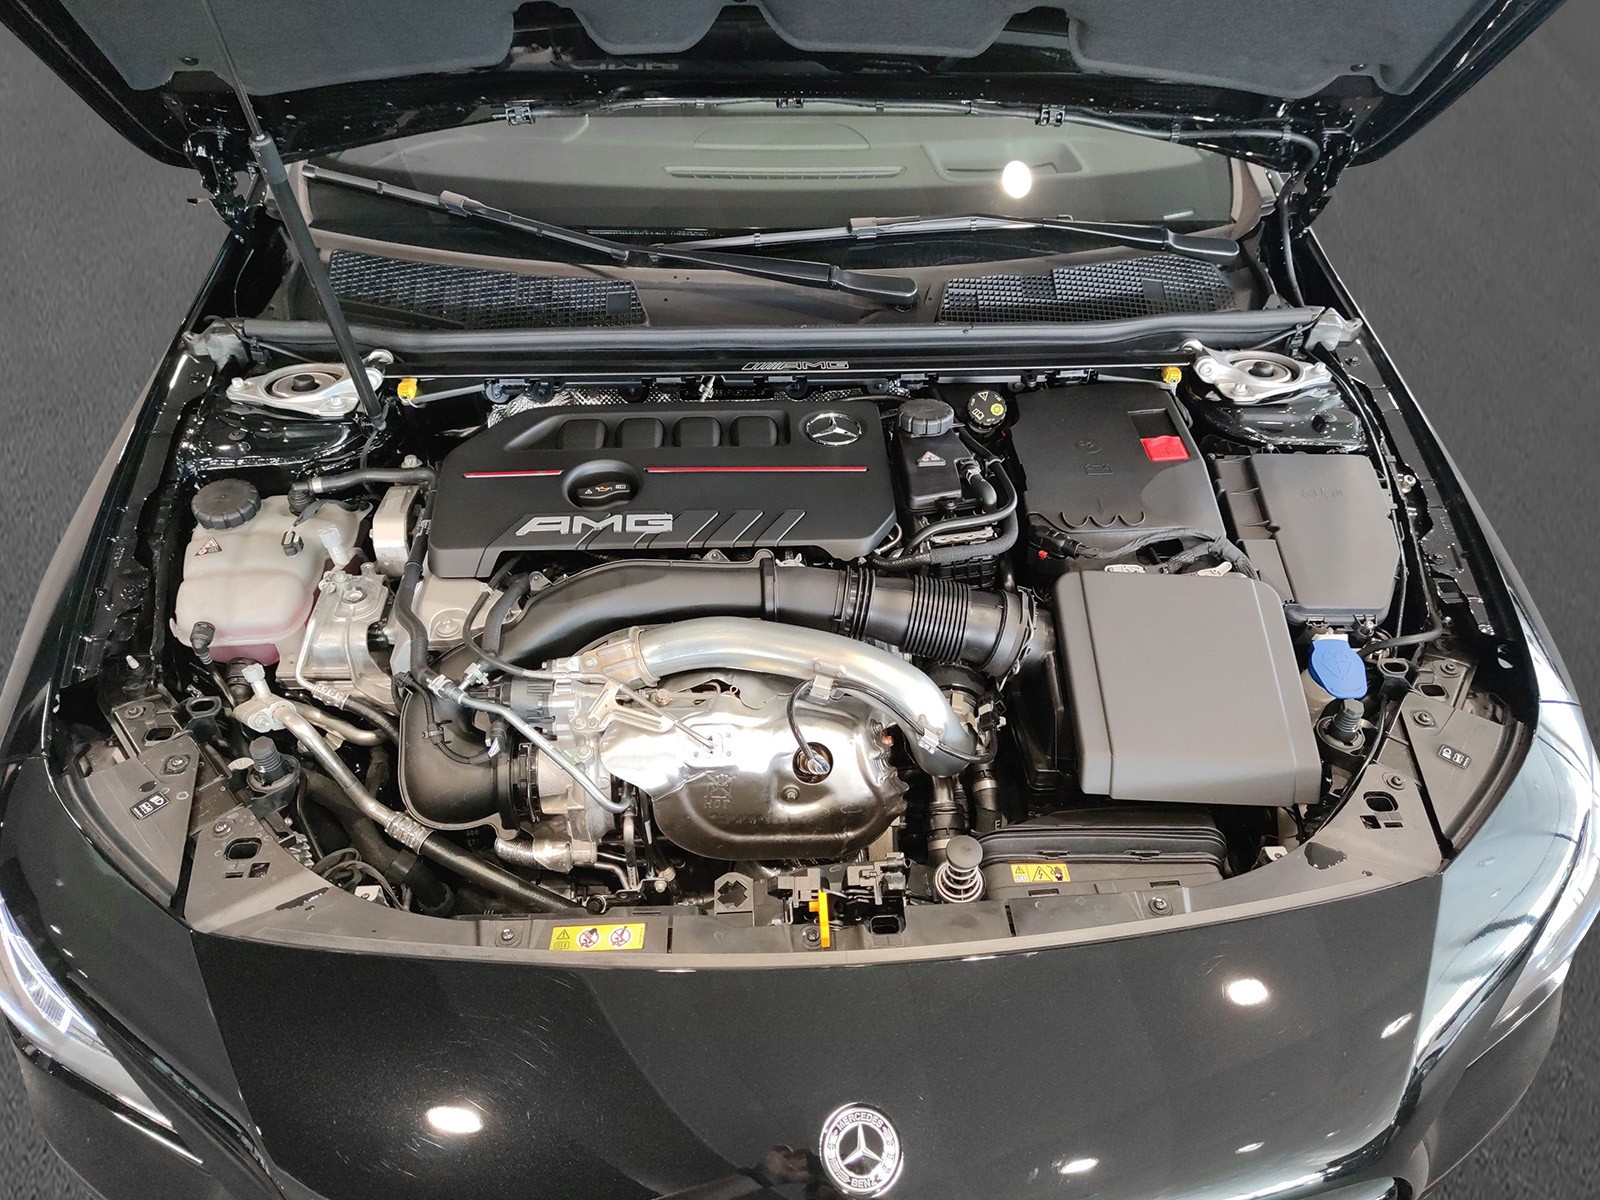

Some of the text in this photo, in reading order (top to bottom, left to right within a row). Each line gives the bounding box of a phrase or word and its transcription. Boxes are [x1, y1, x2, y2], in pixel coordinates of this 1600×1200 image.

[779, 361, 849, 370] AMG
[515, 513, 673, 536] AMG
[703, 799, 731, 809] HOT
[836, 1112, 884, 1130] MERCEDES
[850, 1174, 881, 1188] BENZ
